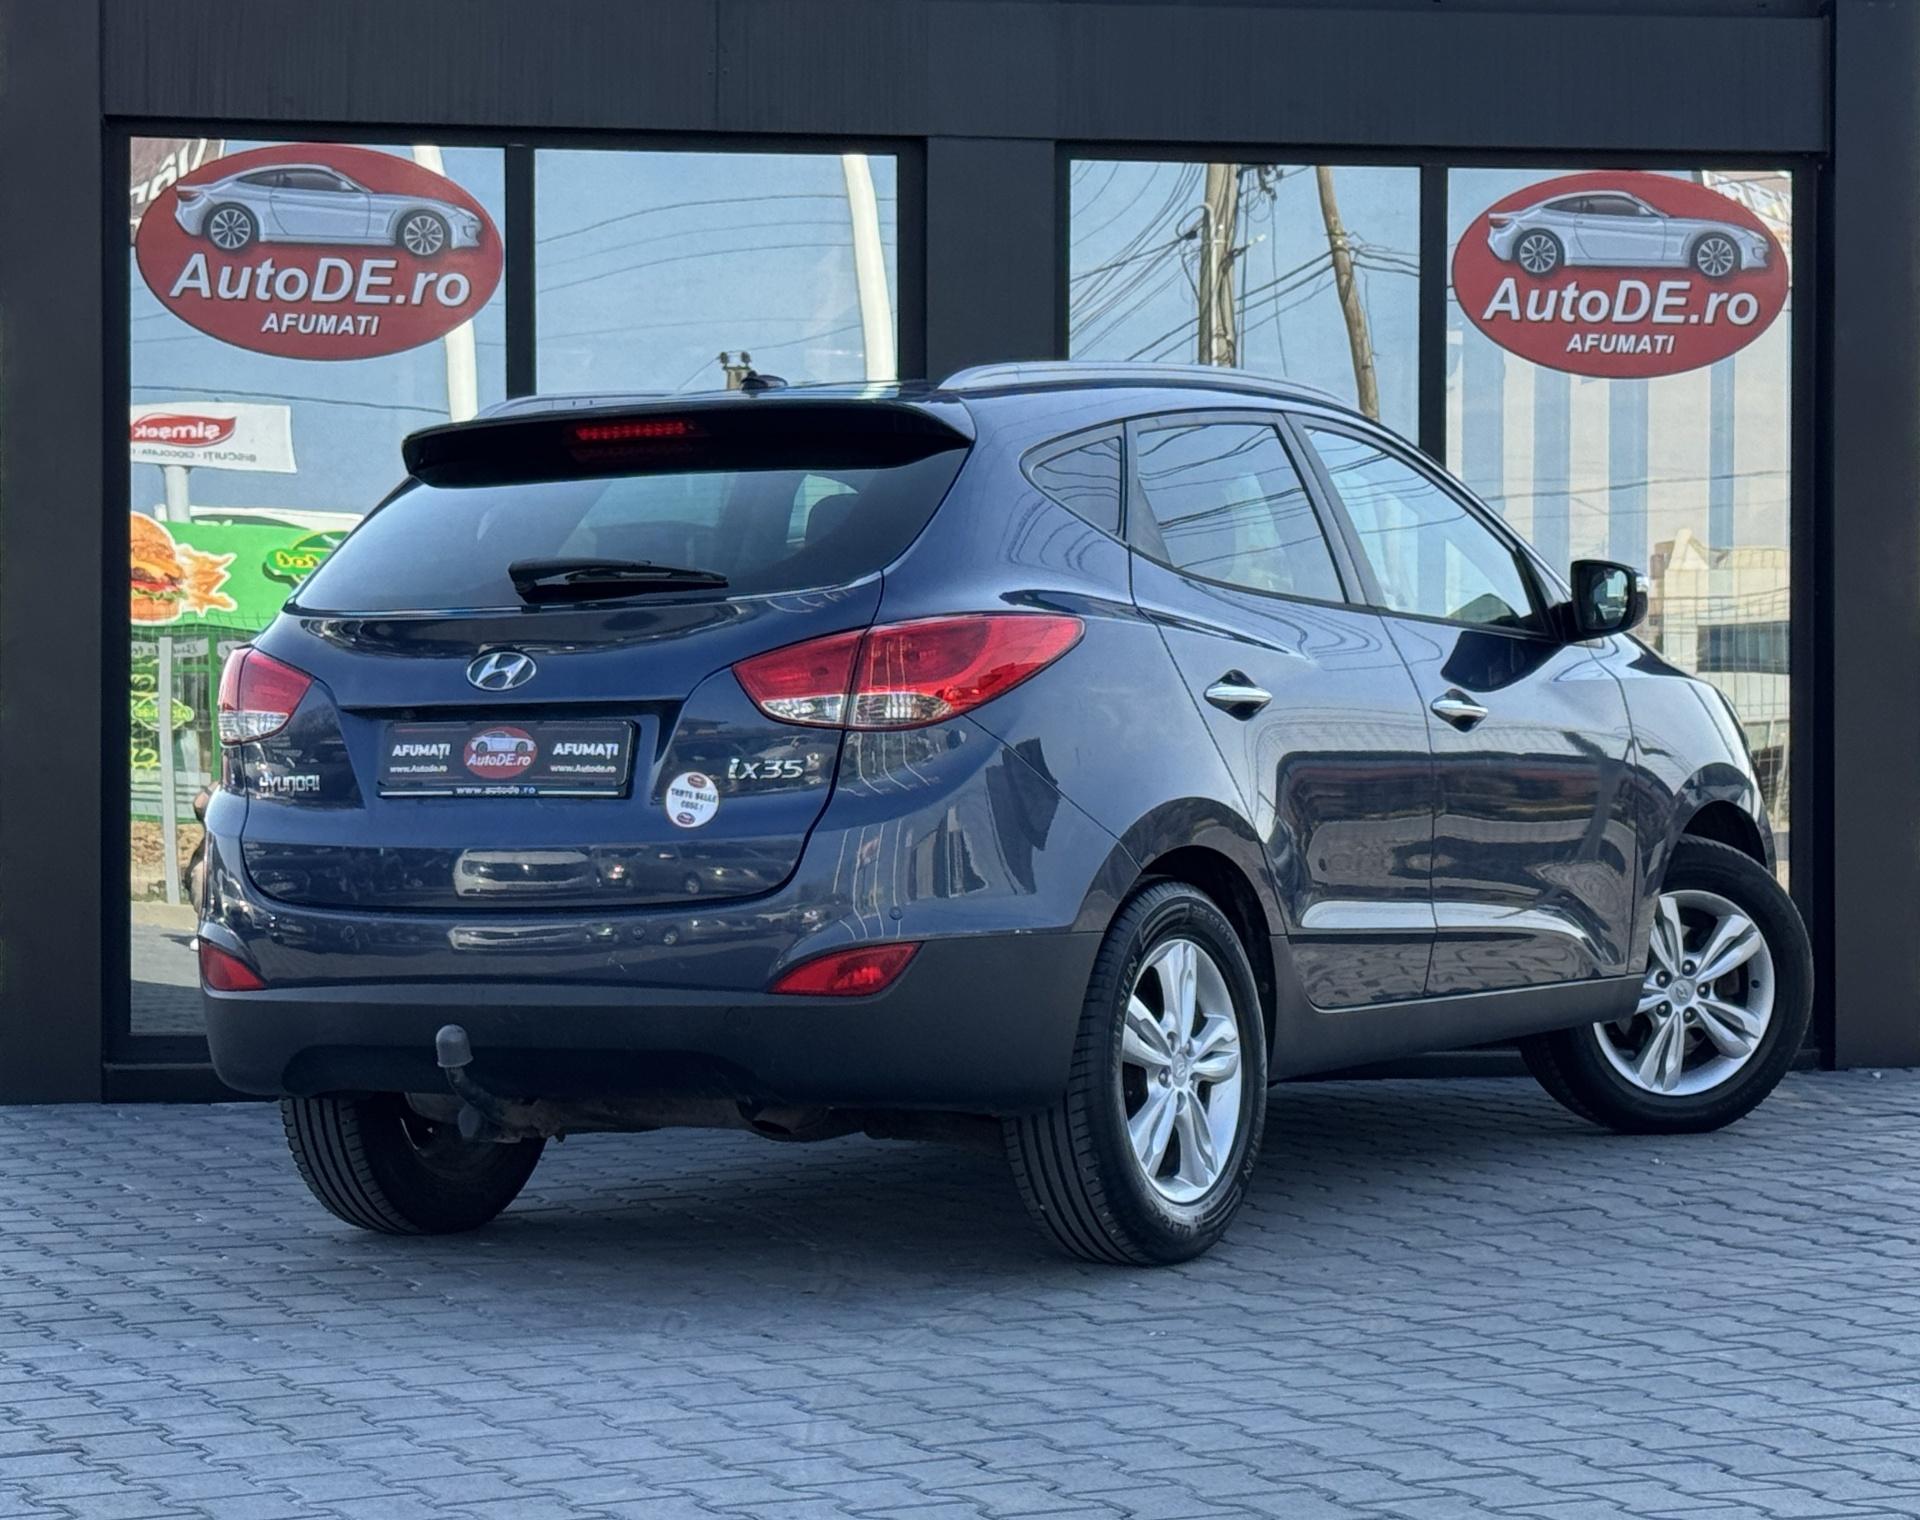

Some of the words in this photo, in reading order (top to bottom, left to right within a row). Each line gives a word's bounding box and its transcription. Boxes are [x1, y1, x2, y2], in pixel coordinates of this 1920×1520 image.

[169, 251, 472, 308] AutoDE.ro
[1482, 277, 1759, 326] AutoDE.ro
[260, 312, 381, 337] AFUMATI
[1566, 333, 1675, 354] AFUMATI
[466, 753, 532, 767] AutoDE.ro
[727, 758, 805, 780] ix35
[258, 774, 321, 792] HYUNDAI
